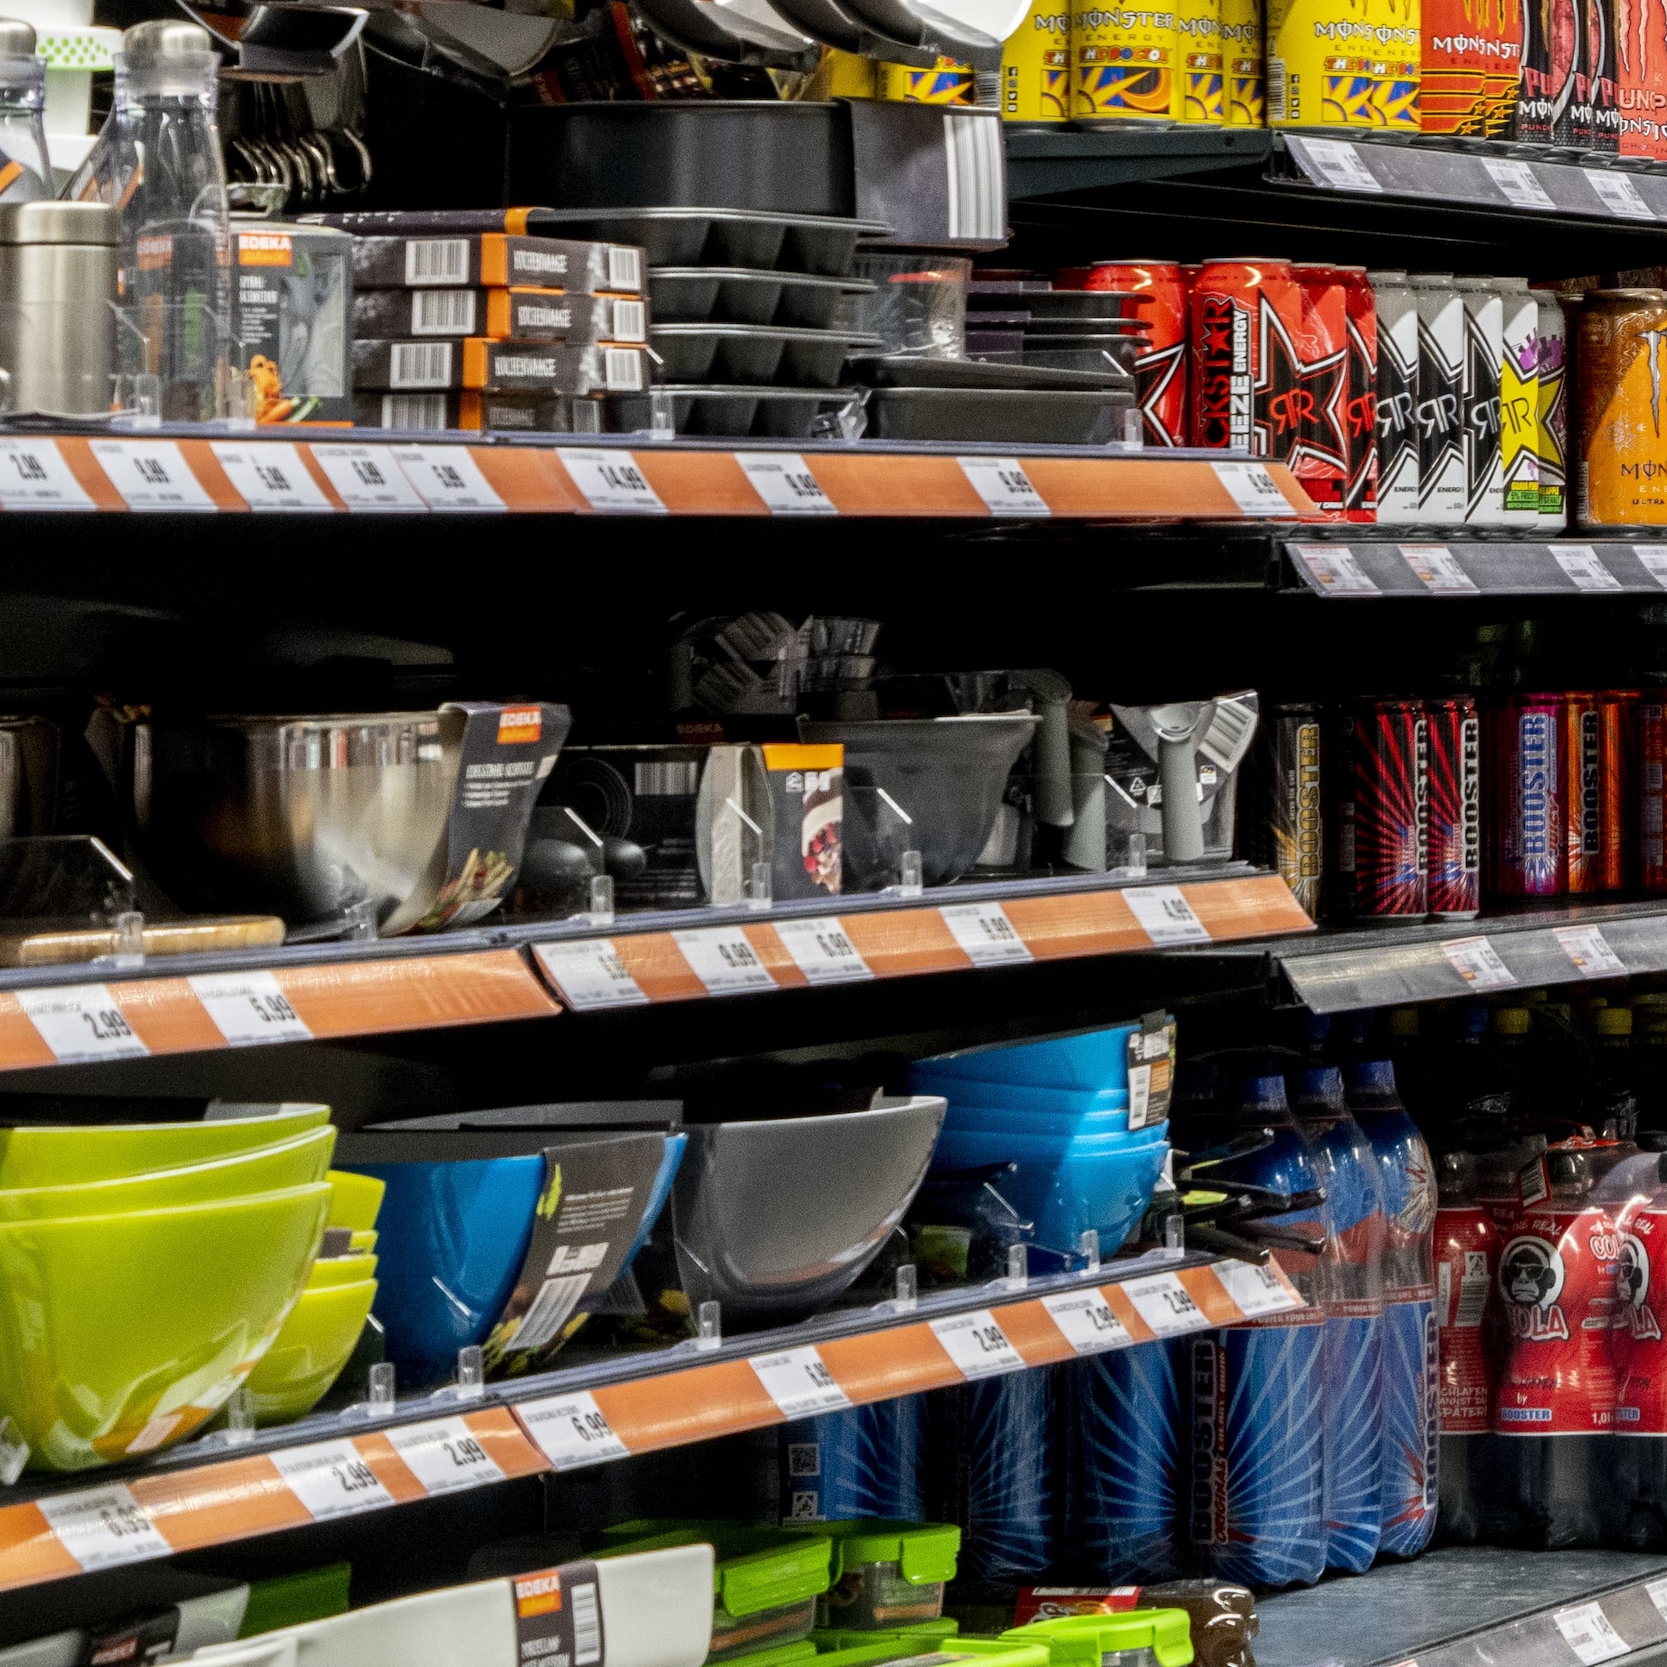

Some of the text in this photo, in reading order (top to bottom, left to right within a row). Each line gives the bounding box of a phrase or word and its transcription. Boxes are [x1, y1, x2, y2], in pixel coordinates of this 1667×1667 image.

[1085, 34, 1164, 42] ENERGY
[239, 236, 292, 252] EDEKA
[1232, 308, 1248, 377] ENERGY
[17, 453, 47, 481] 2.99
[255, 465, 291, 492] 5.99
[597, 465, 649, 493] 14.99
[502, 710, 542, 725] EDEKA
[1414, 719, 1428, 873] BOOSTER
[1461, 718, 1479, 873] BOOSTER
[1519, 712, 1551, 857] BOOSTER
[1581, 711, 1600, 855] BOOSTER
[1298, 724, 1320, 878] BOOSTER
[250, 993, 297, 1024] 5.99
[82, 1011, 133, 1040] 2.99
[1163, 1287, 1193, 1314] 2.99
[972, 1327, 1008, 1353] 2.99
[571, 1413, 609, 1444] 6.99
[1500, 1408, 1552, 1422] BOOSTER
[442, 1438, 486, 1469] 2.99
[335, 1463, 379, 1493] 2.99
[517, 1576, 561, 1599] EDEKA
